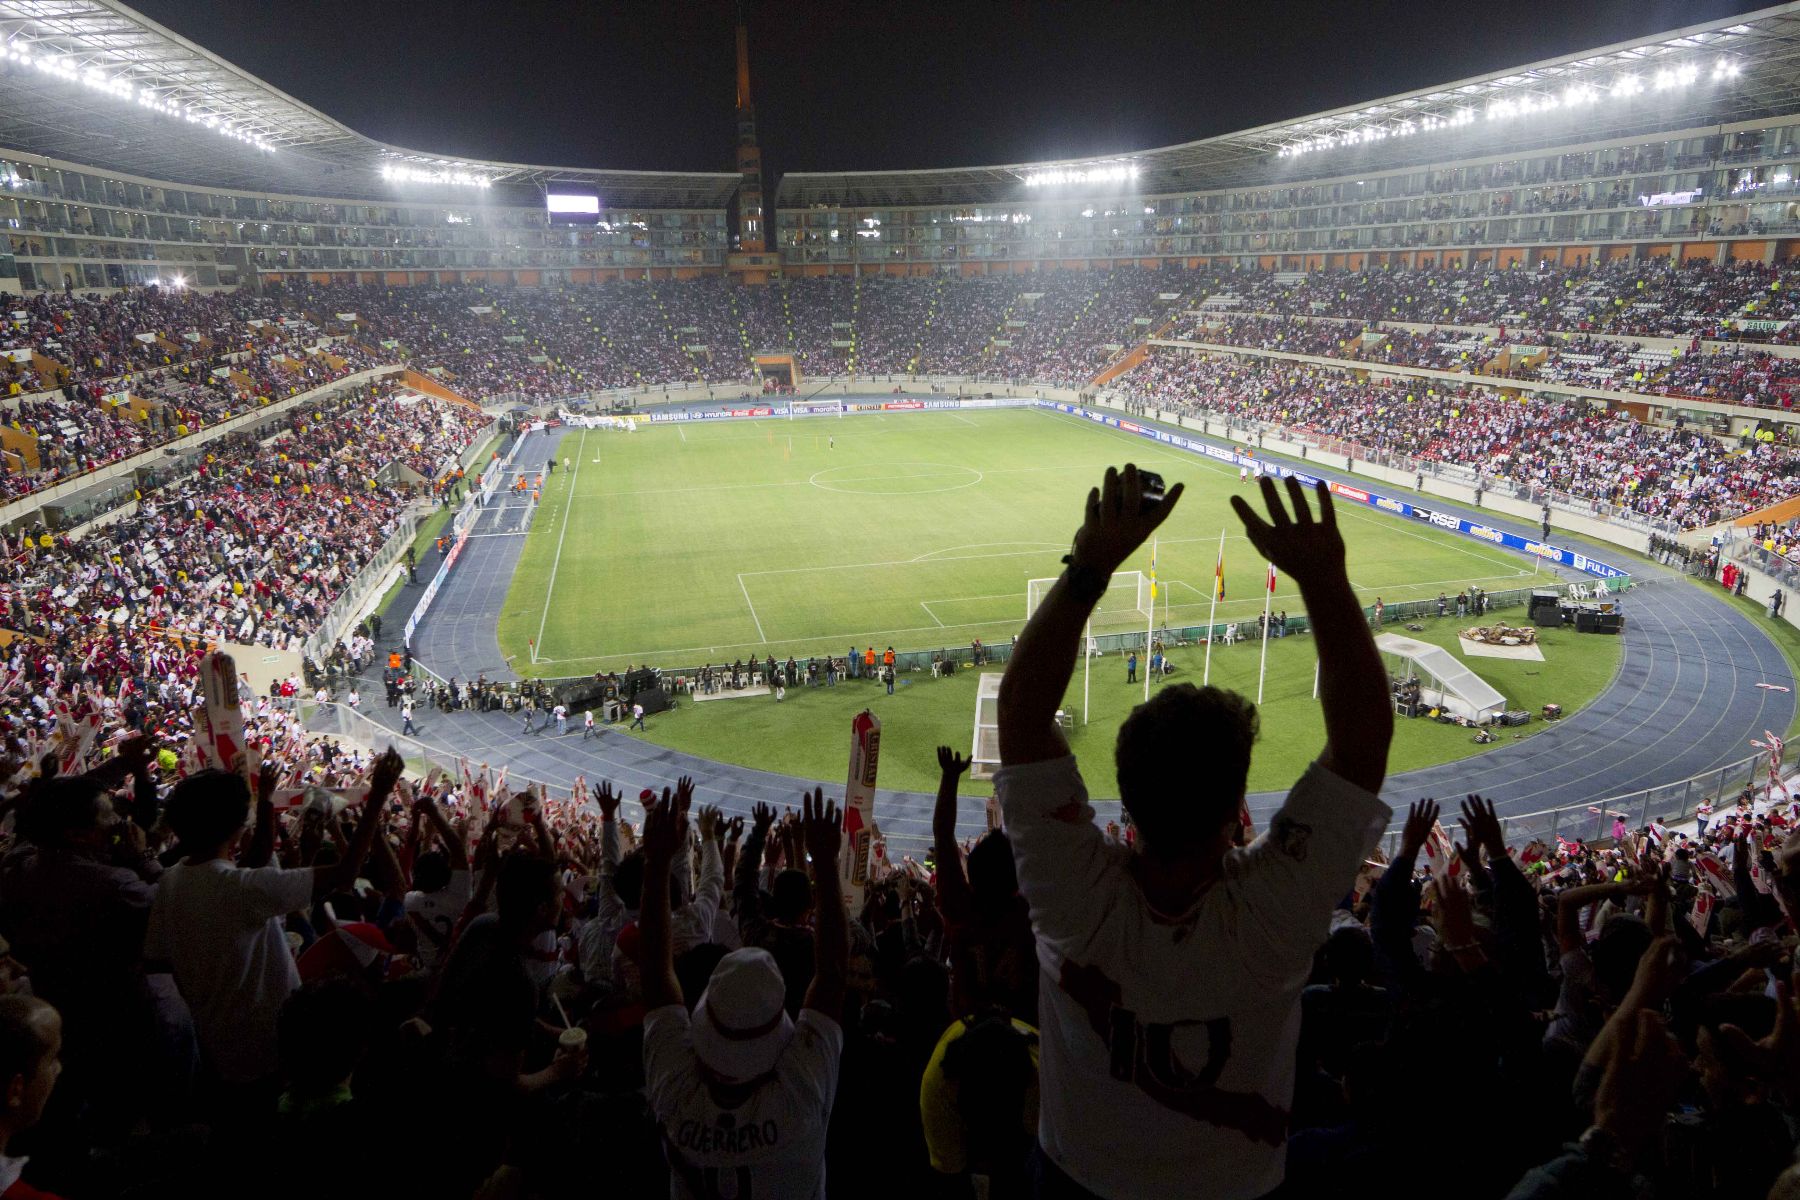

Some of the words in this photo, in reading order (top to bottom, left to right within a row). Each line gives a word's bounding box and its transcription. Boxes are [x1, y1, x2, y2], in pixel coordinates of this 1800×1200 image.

[1747, 321, 1777, 330] SALIDA
[813, 405, 844, 413] marathon
[923, 400, 960, 409] SAMSUNG
[652, 413, 689, 421] SAMSUNG
[1587, 560, 1607, 576] FULL
[867, 733, 879, 785] CRISTAL
[1109, 1003, 1231, 1091] 10
[678, 1118, 778, 1154] GUERRERO
